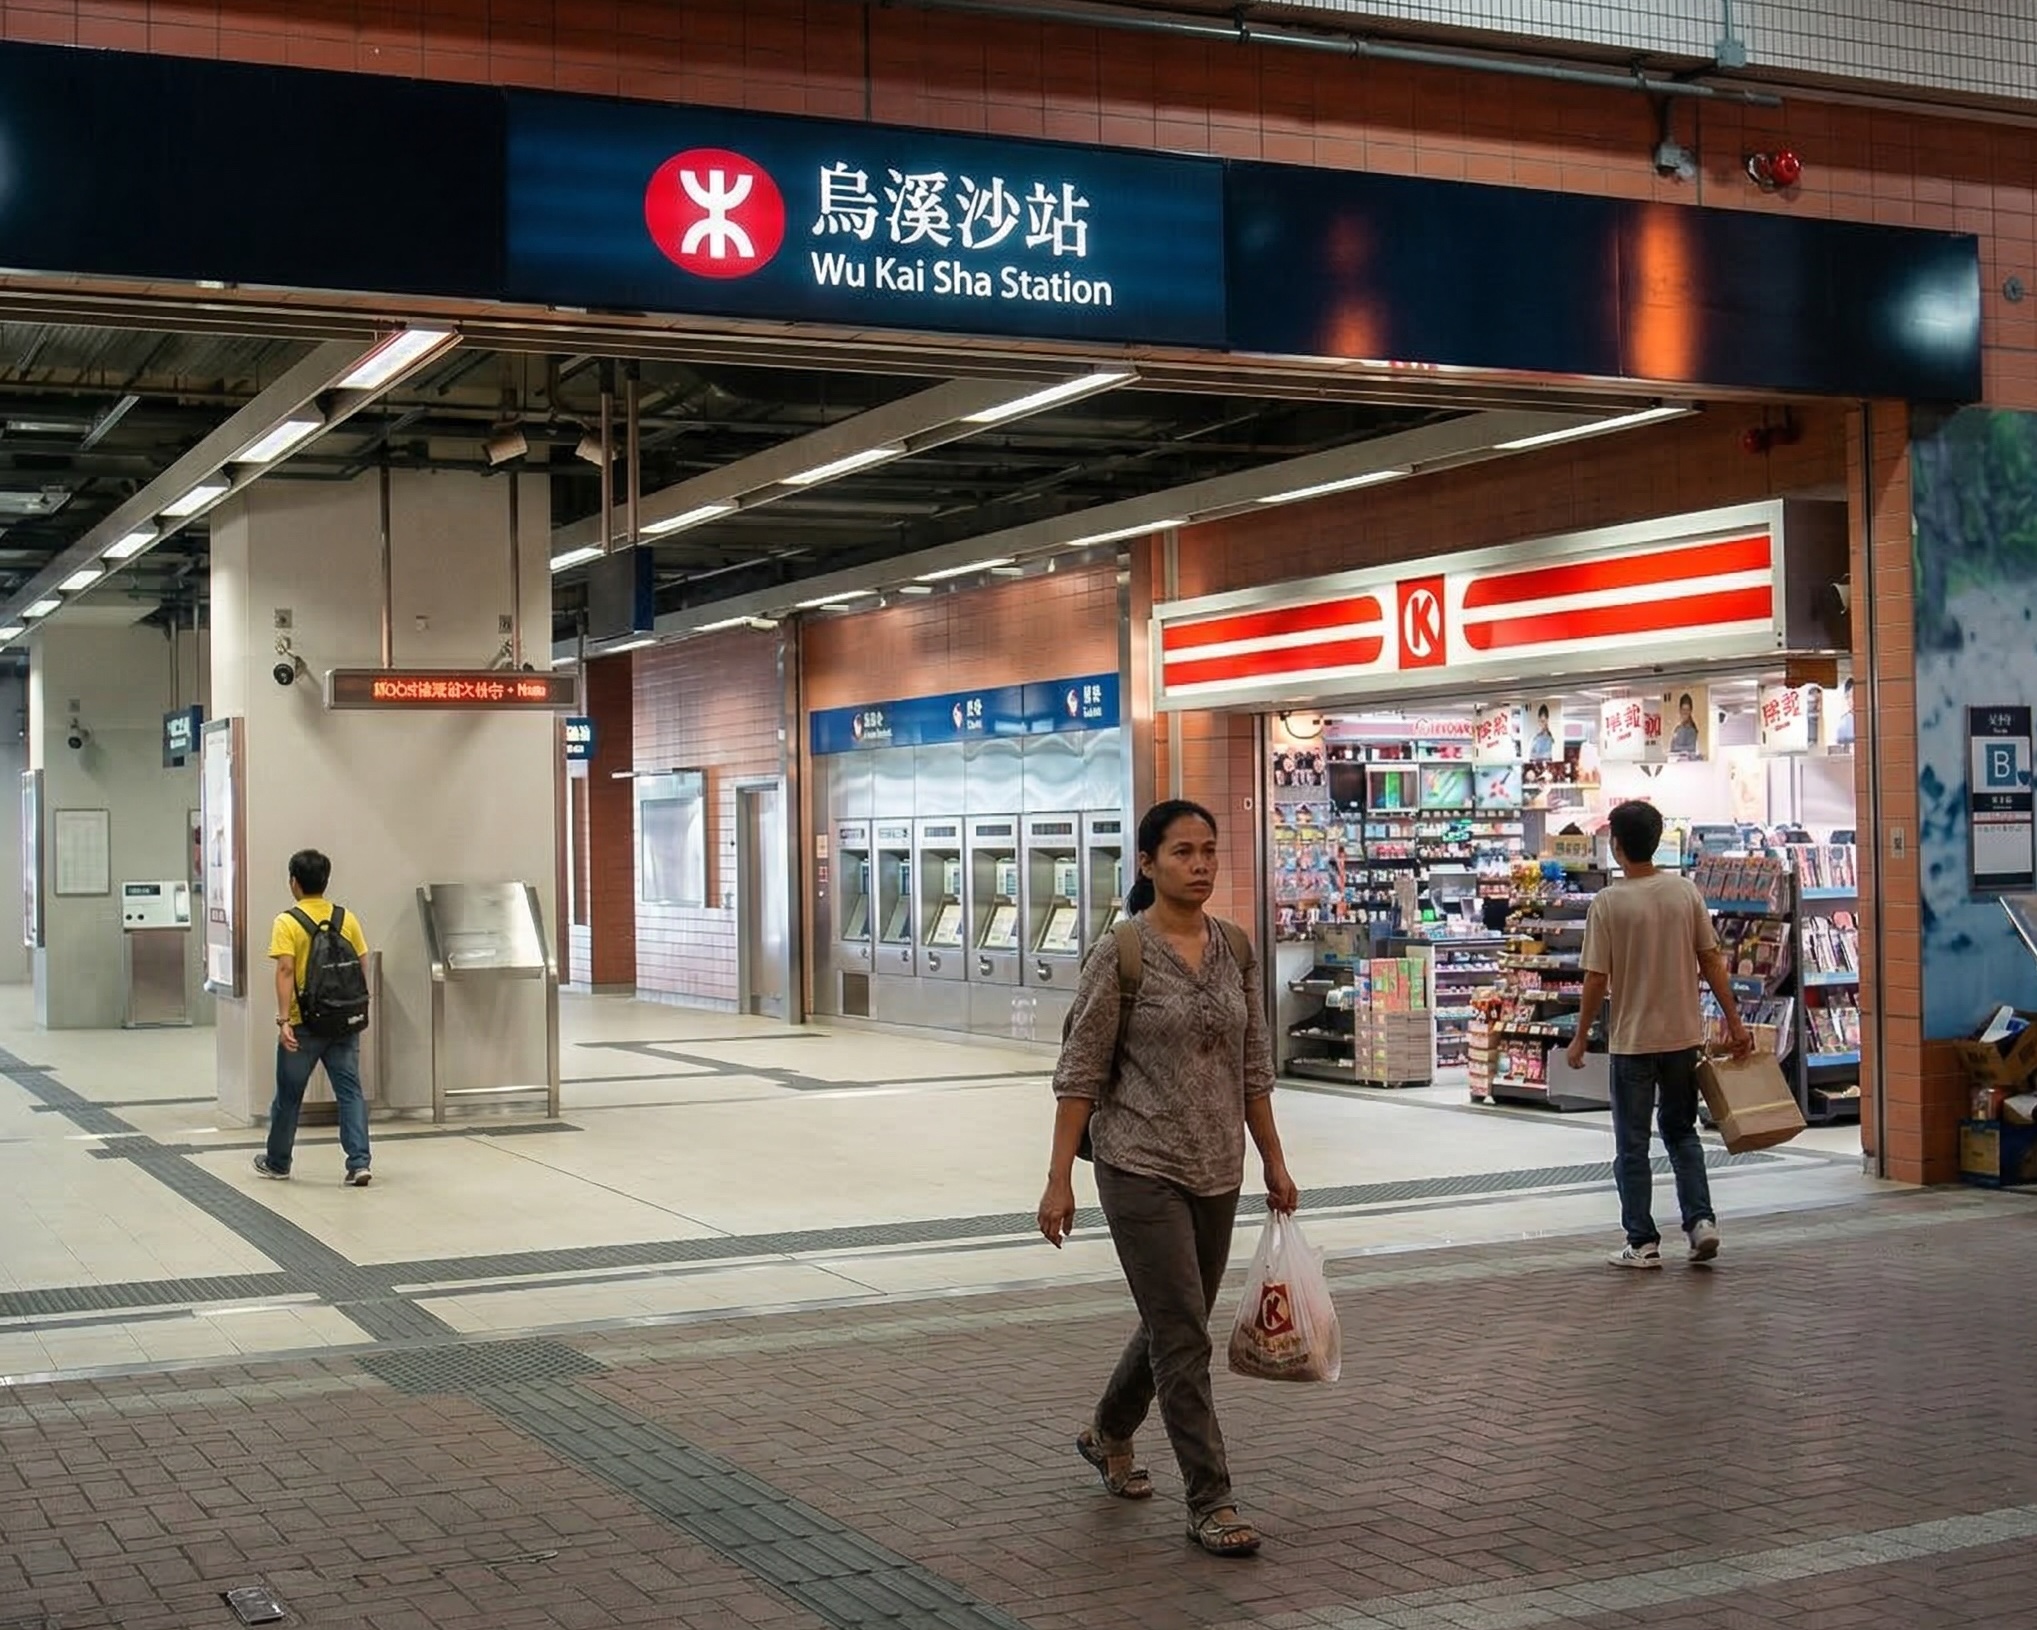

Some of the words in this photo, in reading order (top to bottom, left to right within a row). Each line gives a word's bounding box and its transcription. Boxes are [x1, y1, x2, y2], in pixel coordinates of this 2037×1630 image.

[812, 161, 1090, 258] 烏溪沙站
[811, 251, 865, 288] Wu
[875, 256, 924, 293] Kai
[933, 260, 992, 297] Sha
[1000, 266, 1112, 306] Station
[1408, 592, 1439, 654] K
[1994, 751, 2010, 778] B
